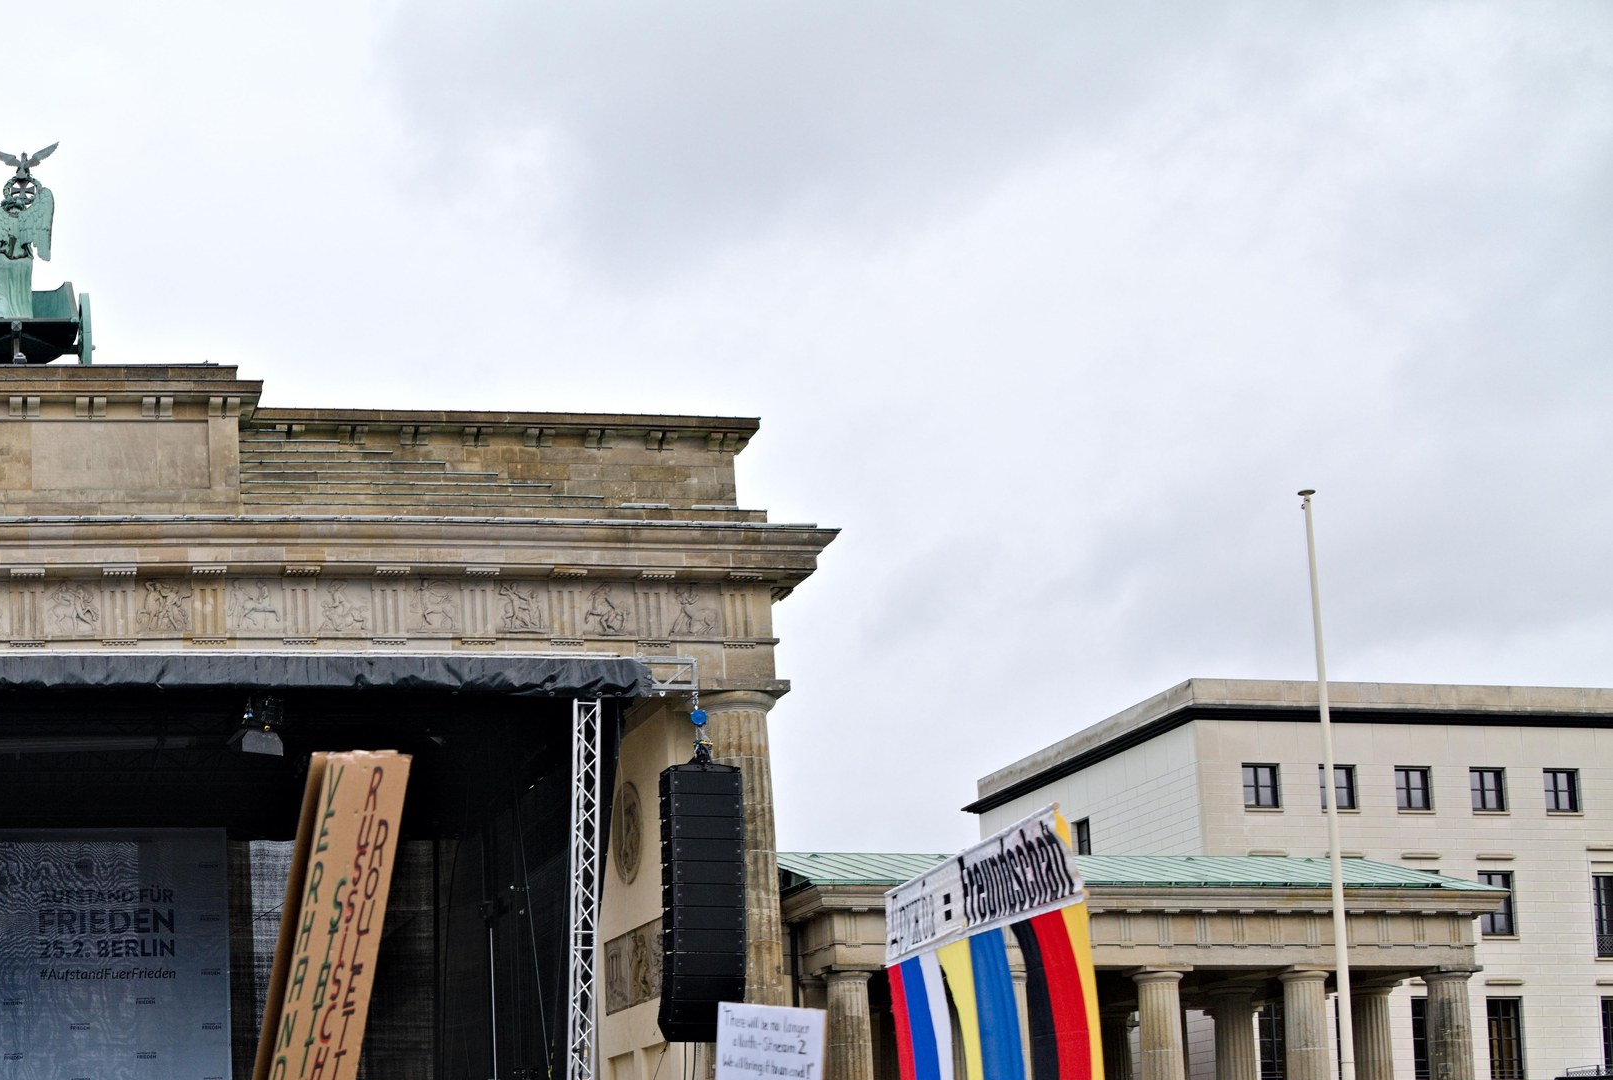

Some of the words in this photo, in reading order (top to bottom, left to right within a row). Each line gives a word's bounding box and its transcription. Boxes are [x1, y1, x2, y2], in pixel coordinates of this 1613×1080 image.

[958, 820, 1075, 927] Freundschaft
[140, 884, 174, 904] FÜR
[38, 908, 175, 935] FRIEDEN
[97, 938, 175, 958] BERLIN
[40, 967, 176, 982] #AufstandFuerFrieden
[798, 1039, 807, 1055] 2
